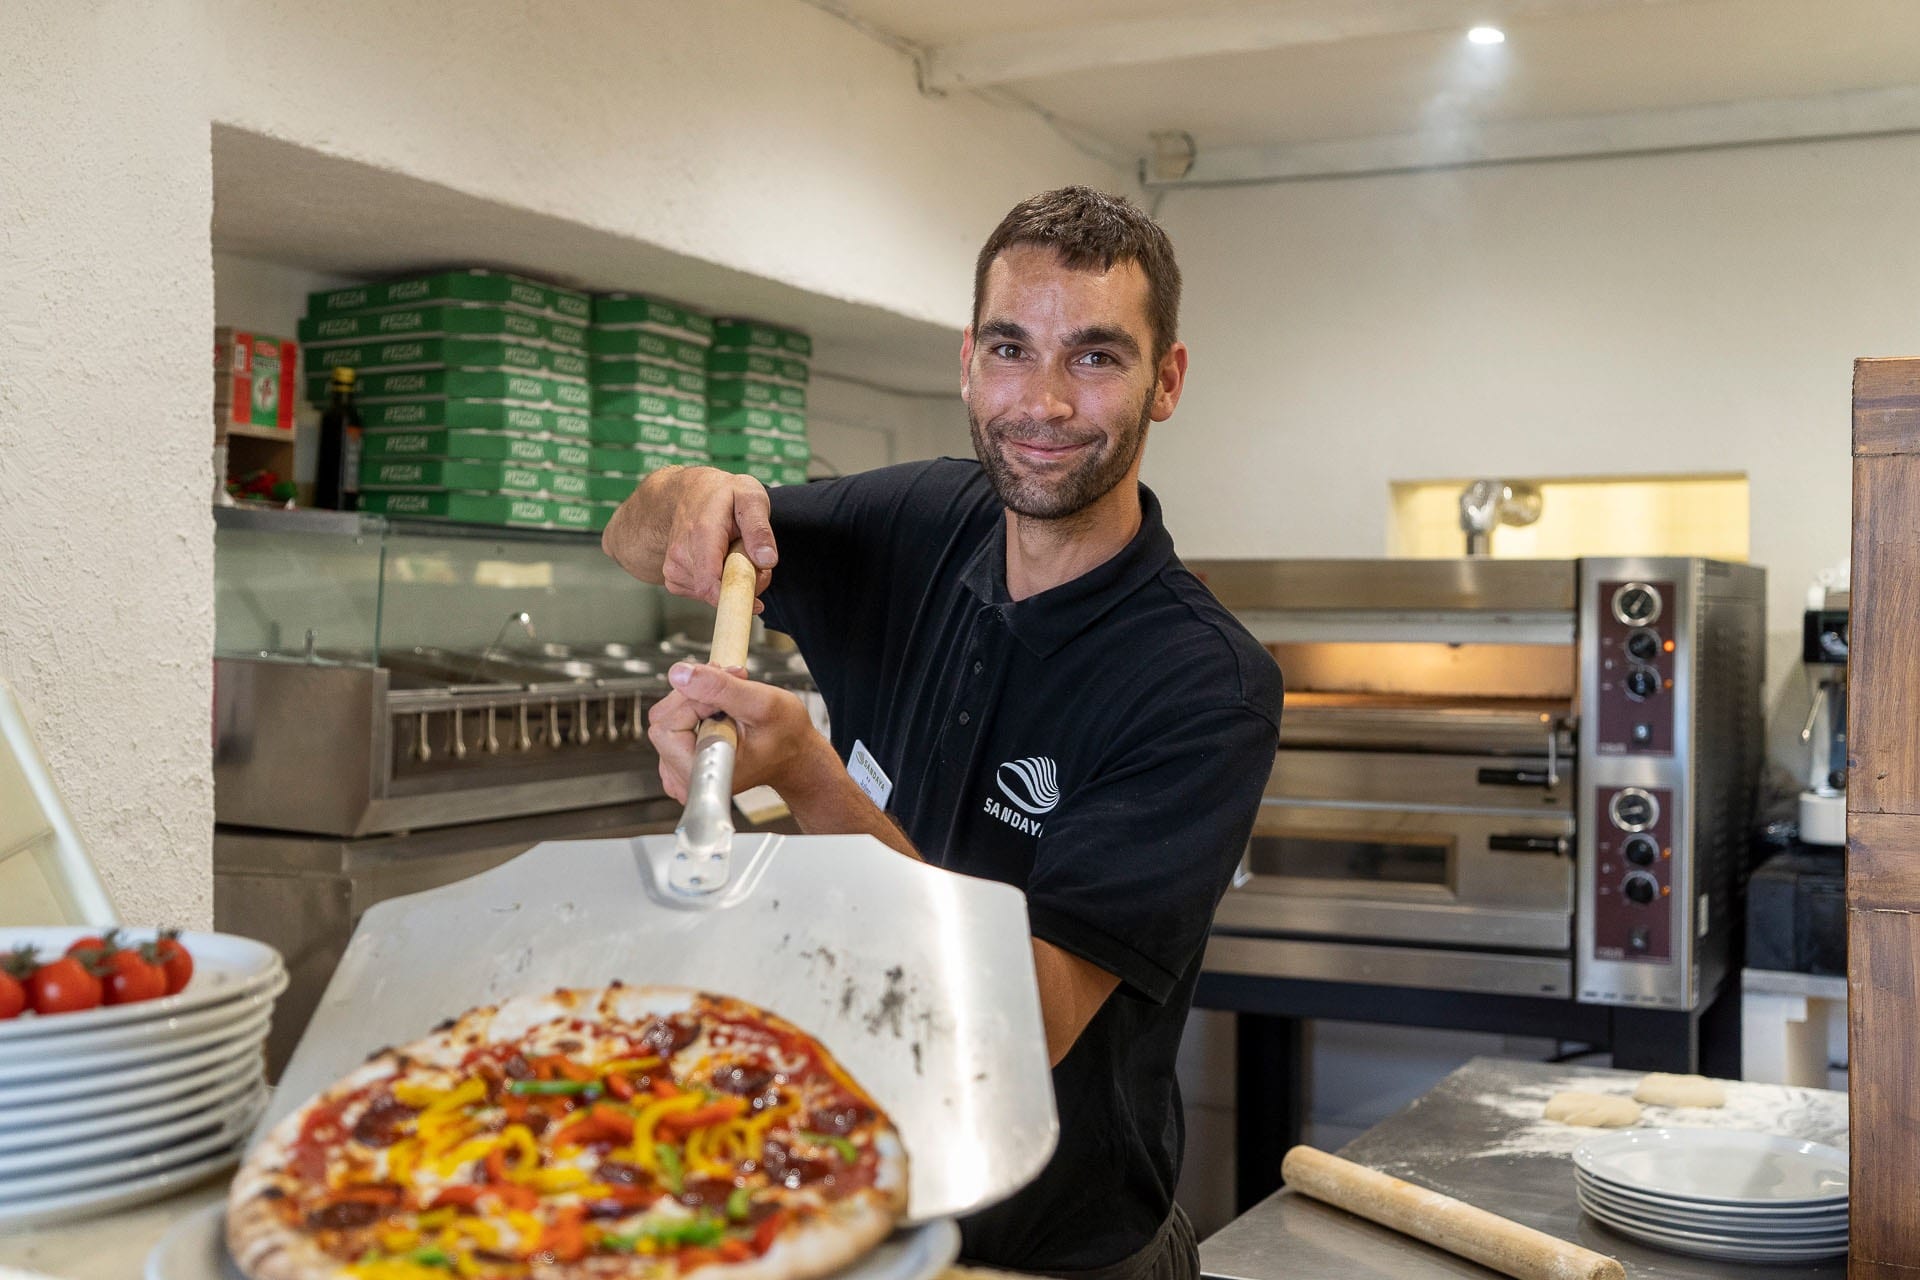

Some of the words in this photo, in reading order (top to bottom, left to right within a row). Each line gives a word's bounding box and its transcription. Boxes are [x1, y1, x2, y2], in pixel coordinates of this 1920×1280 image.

[388, 280, 430, 301] PIZZA
[380, 312, 422, 331] PIZZA
[382, 343, 423, 361] PIZZA
[384, 374, 426, 392] PIZZA
[384, 405, 426, 422] PIZZA
[385, 435, 428, 452] PIZZA
[380, 464, 422, 481] PIZZA
[386, 494, 429, 512] PIZZA
[864, 760, 885, 791] SANDAYA
